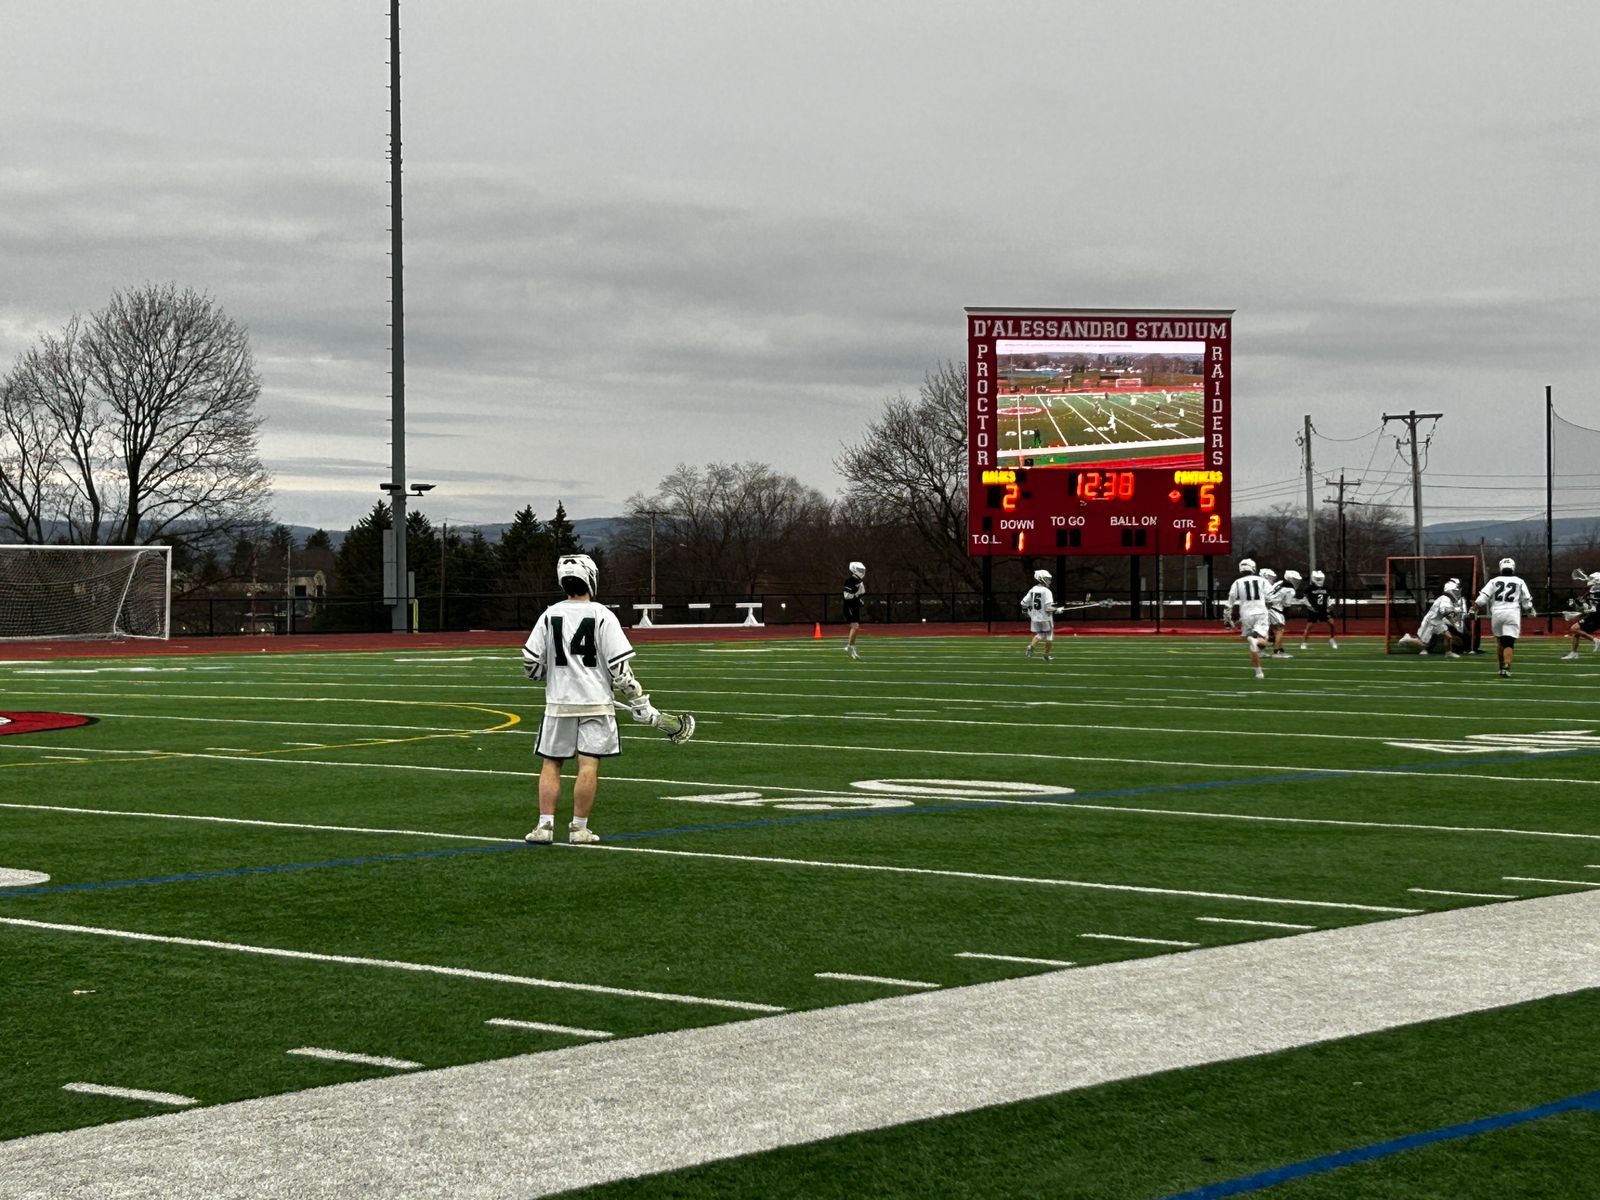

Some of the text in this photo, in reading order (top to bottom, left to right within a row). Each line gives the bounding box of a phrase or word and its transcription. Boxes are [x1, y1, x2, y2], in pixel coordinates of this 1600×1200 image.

[974, 320, 1228, 340] D'ALESSANDRO STADIUM
[977, 344, 989, 465] PROCTOR
[1211, 346, 1224, 465] RAIDERS
[1003, 484, 1019, 509] 2
[1200, 484, 1215, 509] 5
[1000, 520, 1035, 530] DOWN
[1050, 516, 1085, 526] TO GO
[1110, 516, 1157, 526] BALL ON
[1207, 514, 1220, 532] 2
[1018, 531, 1025, 552] 1
[1185, 531, 1192, 551] 1
[1244, 580, 1260, 600] 11
[1494, 581, 1517, 602] 22
[551, 616, 597, 668] 14
